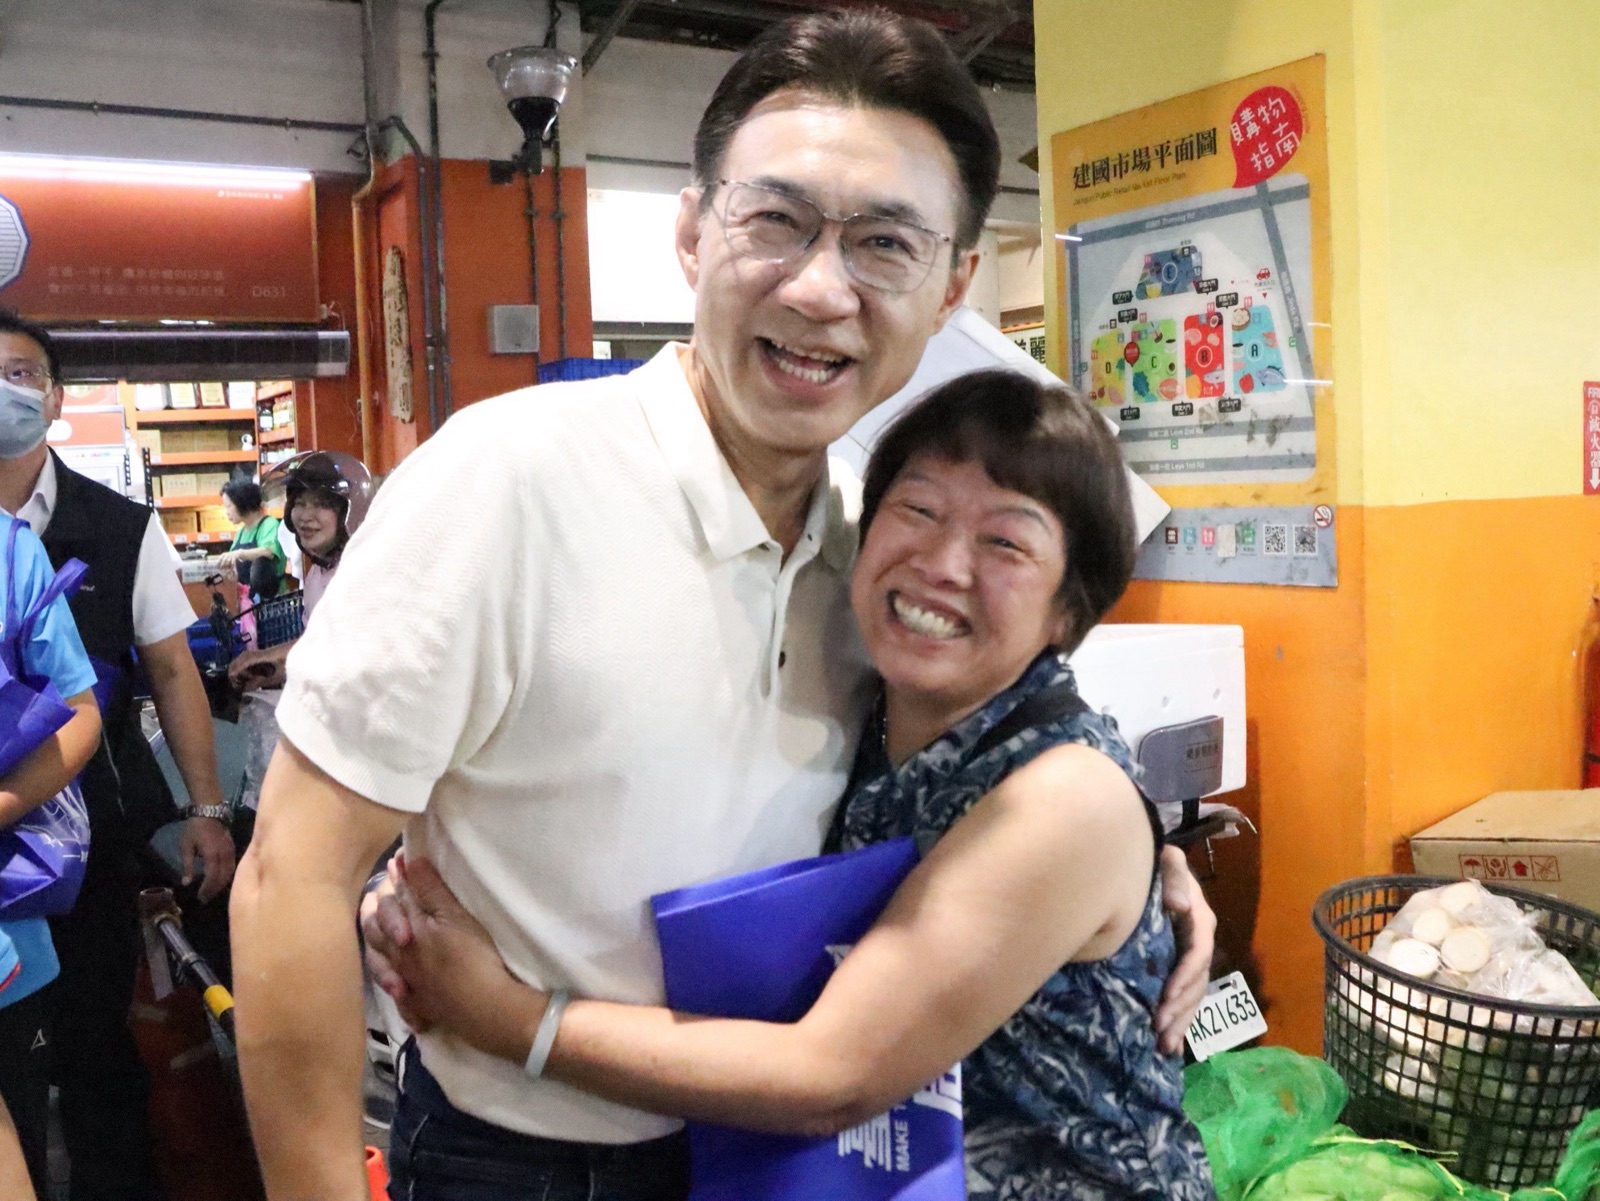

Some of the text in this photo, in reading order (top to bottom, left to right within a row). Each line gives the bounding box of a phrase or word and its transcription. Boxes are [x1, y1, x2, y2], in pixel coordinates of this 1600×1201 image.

[1230, 97, 1287, 146] 購物
[1073, 127, 1218, 191] 建國市場平面圖
[1250, 122, 1300, 172] 指南
[252, 285, 286, 298] D631
[1151, 355, 1157, 369] C
[1200, 349, 1208, 363] B
[1251, 343, 1259, 358] A
[1190, 990, 1257, 1043] AK21633
[894, 1120, 909, 1171] MAKE
